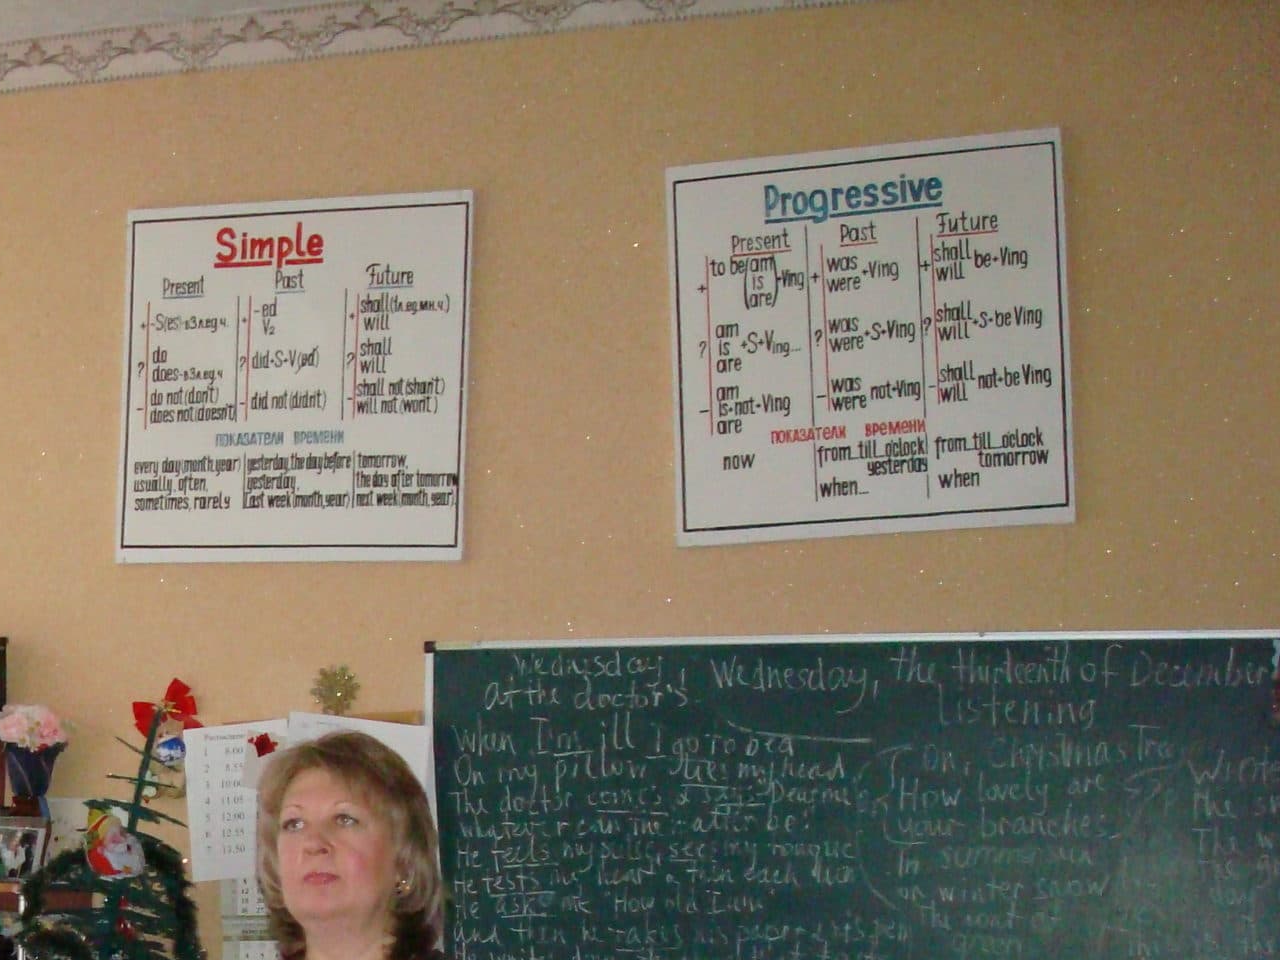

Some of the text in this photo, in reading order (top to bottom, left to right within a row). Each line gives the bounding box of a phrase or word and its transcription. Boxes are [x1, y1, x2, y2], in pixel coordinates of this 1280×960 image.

[764, 174, 943, 223] Progressive
[840, 220, 877, 242] Past
[936, 211, 999, 233] Future
[216, 222, 325, 268] Simple
[731, 228, 790, 252] Present
[934, 238, 972, 261] shall
[710, 259, 725, 276] to
[827, 255, 858, 272] was
[936, 261, 965, 282] will
[275, 269, 304, 288] Past
[366, 263, 414, 285] Future
[827, 275, 861, 292] were
[163, 275, 204, 295] Present
[360, 292, 389, 313] shall
[750, 292, 773, 307] are
[364, 314, 390, 330] will
[936, 300, 1043, 329] shall Ving
[716, 323, 739, 338] am
[828, 316, 859, 334] was
[938, 321, 970, 341] will
[360, 337, 392, 356] shall
[719, 340, 730, 356] is
[829, 335, 864, 352] were
[152, 346, 167, 364] do
[360, 357, 386, 373] will
[716, 358, 742, 373] are
[939, 360, 1052, 387] shall Ving
[357, 378, 384, 397] shall
[389, 378, 403, 396] not
[716, 385, 739, 401] am
[831, 377, 862, 393] was
[940, 382, 968, 403] will
[151, 389, 163, 406] do
[167, 389, 183, 405] not
[251, 391, 268, 410] did
[271, 389, 288, 409] not
[357, 398, 377, 415] will
[381, 396, 398, 414] not
[831, 394, 867, 411] were
[150, 406, 174, 424] does
[177, 405, 193, 422] not
[717, 419, 742, 434] are
[134, 458, 159, 478] every
[324, 451, 351, 473] before
[723, 454, 755, 470] now
[867, 457, 928, 476] yesterday
[977, 449, 1049, 468] tomorrow
[356, 470, 370, 488] the
[372, 470, 388, 488] day
[391, 469, 414, 491] after
[938, 468, 980, 488] when
[194, 491, 230, 509] rarely
[267, 490, 291, 508] week
[376, 490, 397, 507] week
[890, 646, 938, 683] the
[1080, 643, 1121, 688] of
[937, 684, 1096, 728] Listening
